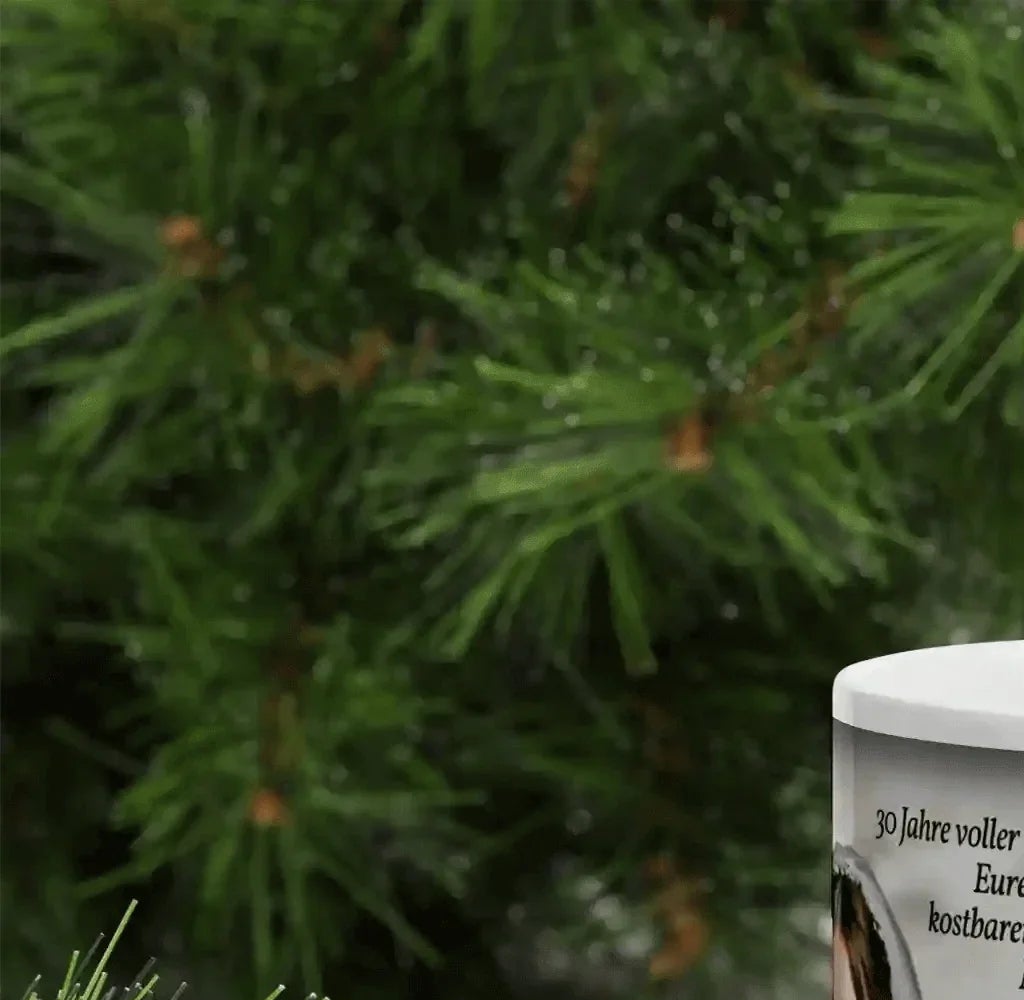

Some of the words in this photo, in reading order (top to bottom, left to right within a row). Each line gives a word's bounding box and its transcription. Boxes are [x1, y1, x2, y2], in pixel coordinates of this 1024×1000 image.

[874, 808, 898, 840] 30
[898, 806, 952, 847] Jahre
[954, 816, 1022, 852] voller
